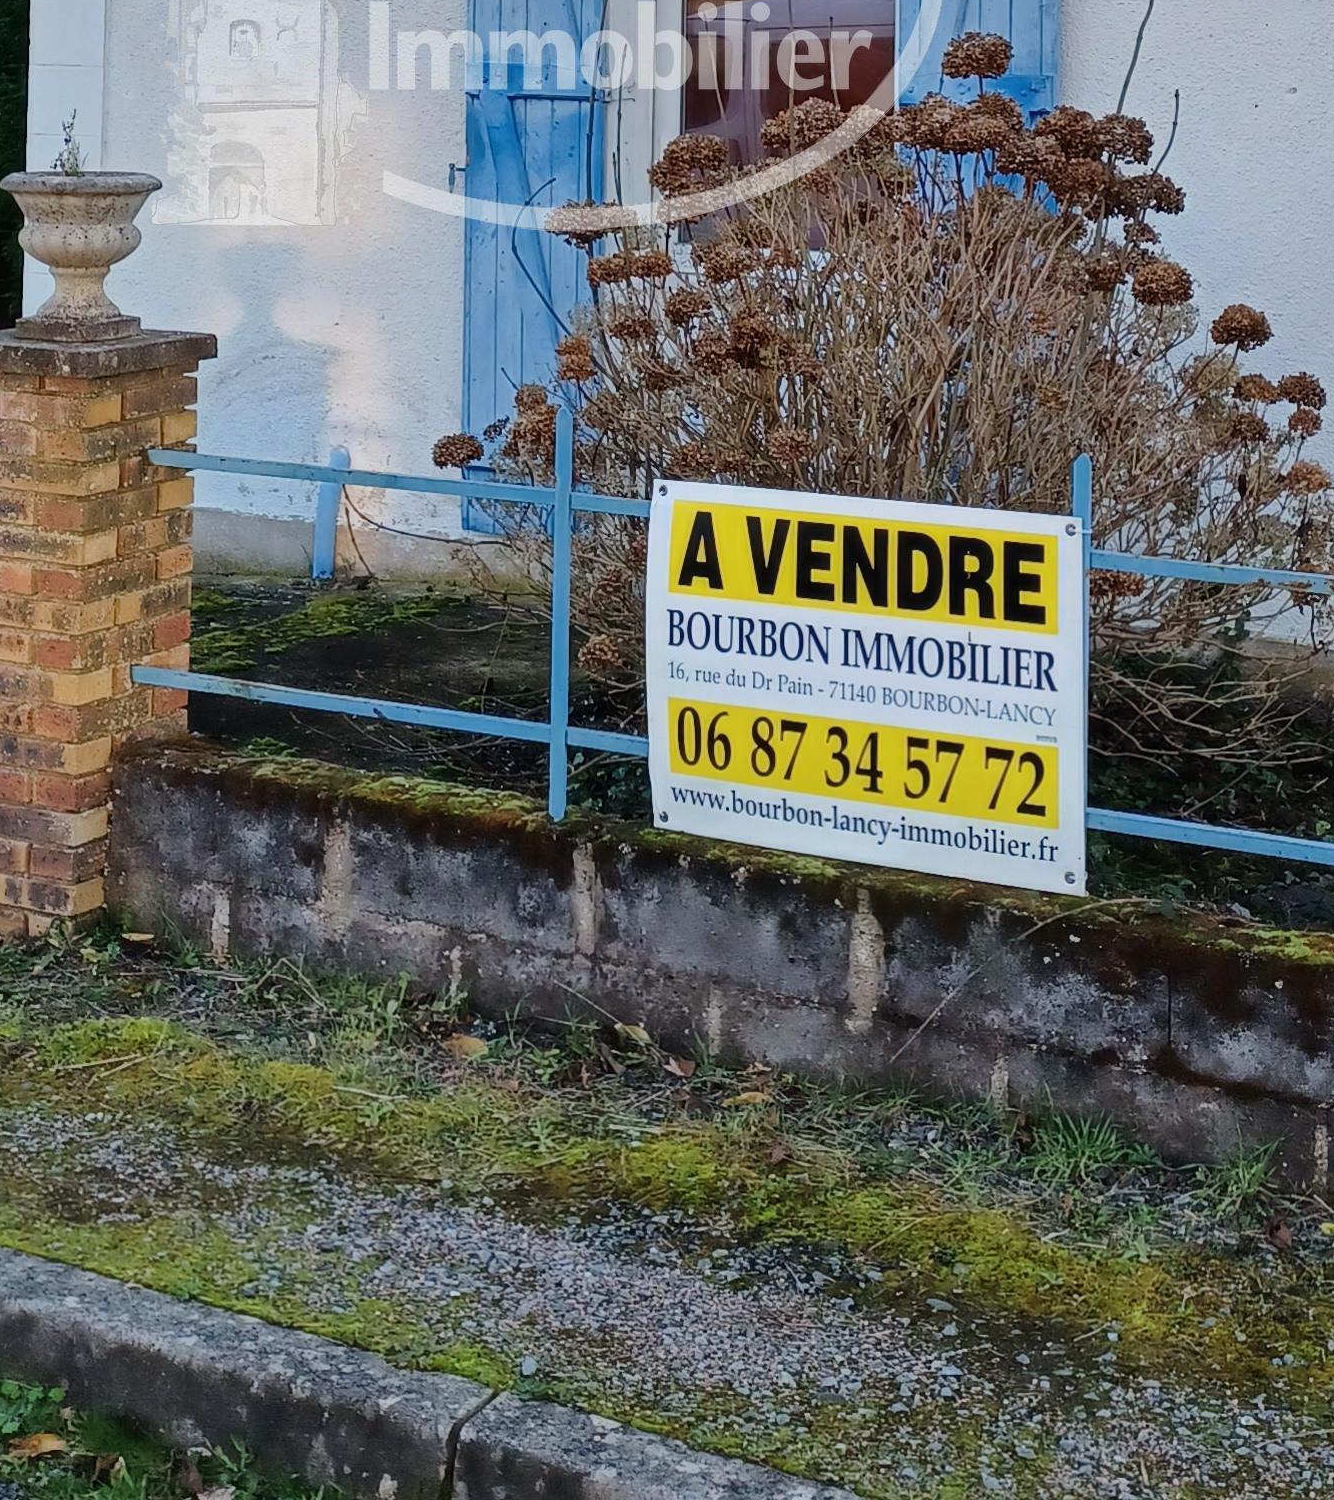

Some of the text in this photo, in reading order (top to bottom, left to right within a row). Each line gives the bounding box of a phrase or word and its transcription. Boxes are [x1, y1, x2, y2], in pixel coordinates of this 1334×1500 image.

[677, 511, 1047, 625] A VENDRE
[667, 608, 1058, 692] BOURBON IMMOBILIER
[668, 661, 689, 683] 16,
[695, 669, 721, 685] rue
[726, 668, 746, 688] du
[752, 671, 772, 691] Dr
[778, 674, 813, 696] Pain
[829, 680, 876, 704] 71140
[881, 687, 1056, 726] BOURBON-LANCY
[677, 706, 1046, 817] 06 87 34 57 72
[671, 786, 1058, 862] www.bourbon-lancy-immobilier.fr
